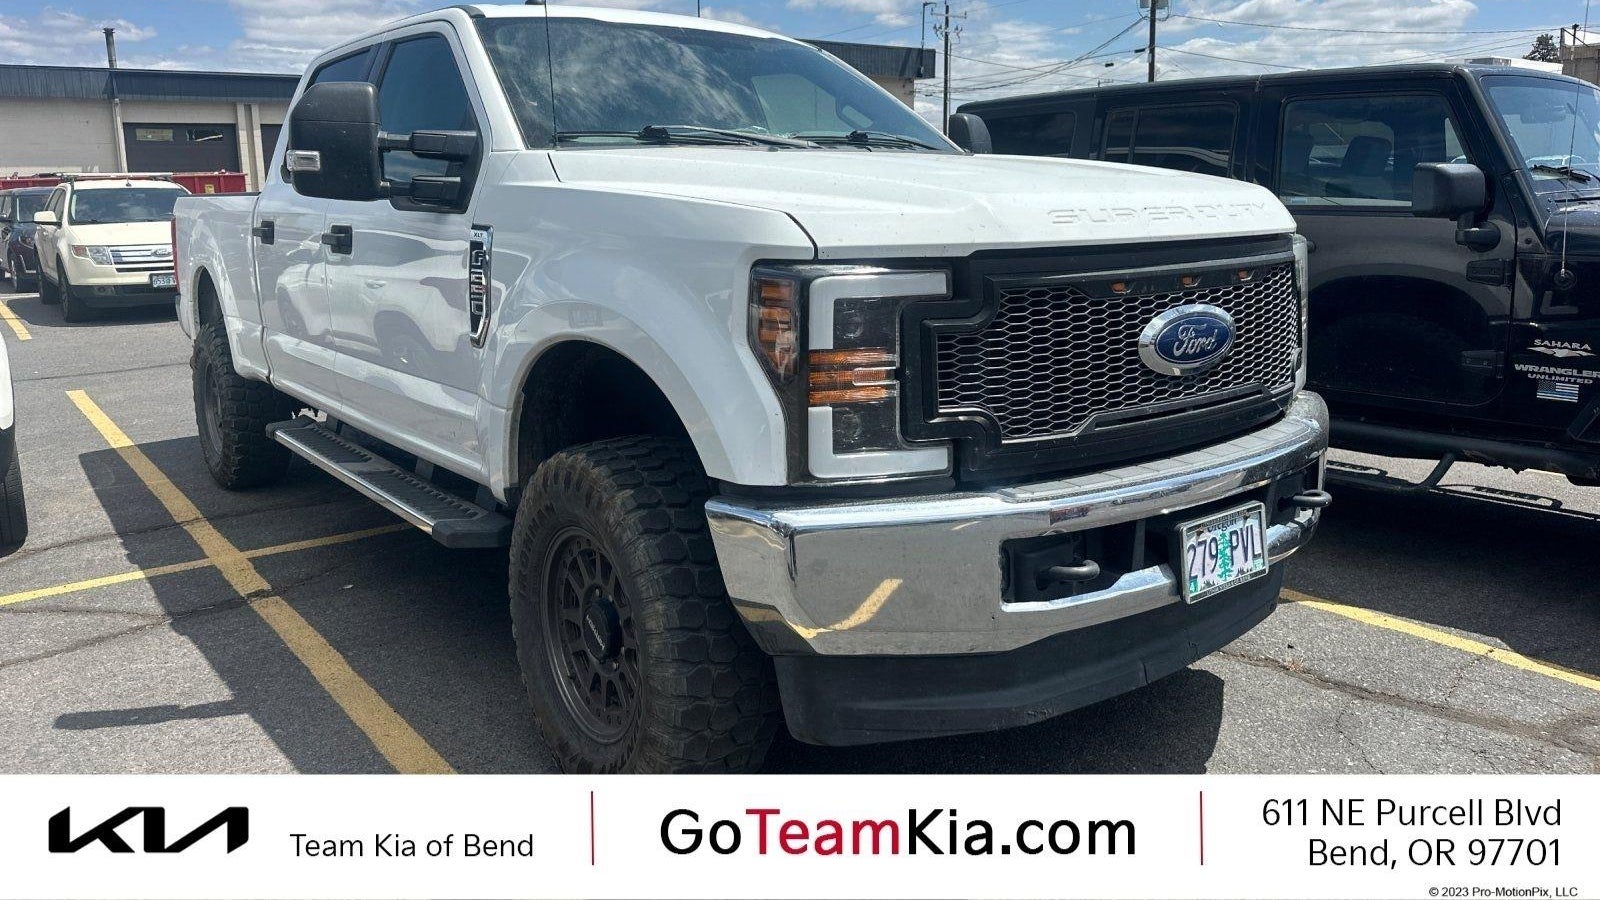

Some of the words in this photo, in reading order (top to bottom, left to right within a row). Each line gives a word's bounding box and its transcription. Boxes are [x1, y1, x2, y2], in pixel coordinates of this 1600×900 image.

[1173, 323, 1218, 357] Ford
[1534, 339, 1592, 351] SAHARA
[1514, 363, 1600, 379] WRANGLER
[1527, 373, 1593, 384] UNLIMITED
[1187, 536, 1219, 579] 279
[1229, 524, 1262, 567] PVL
